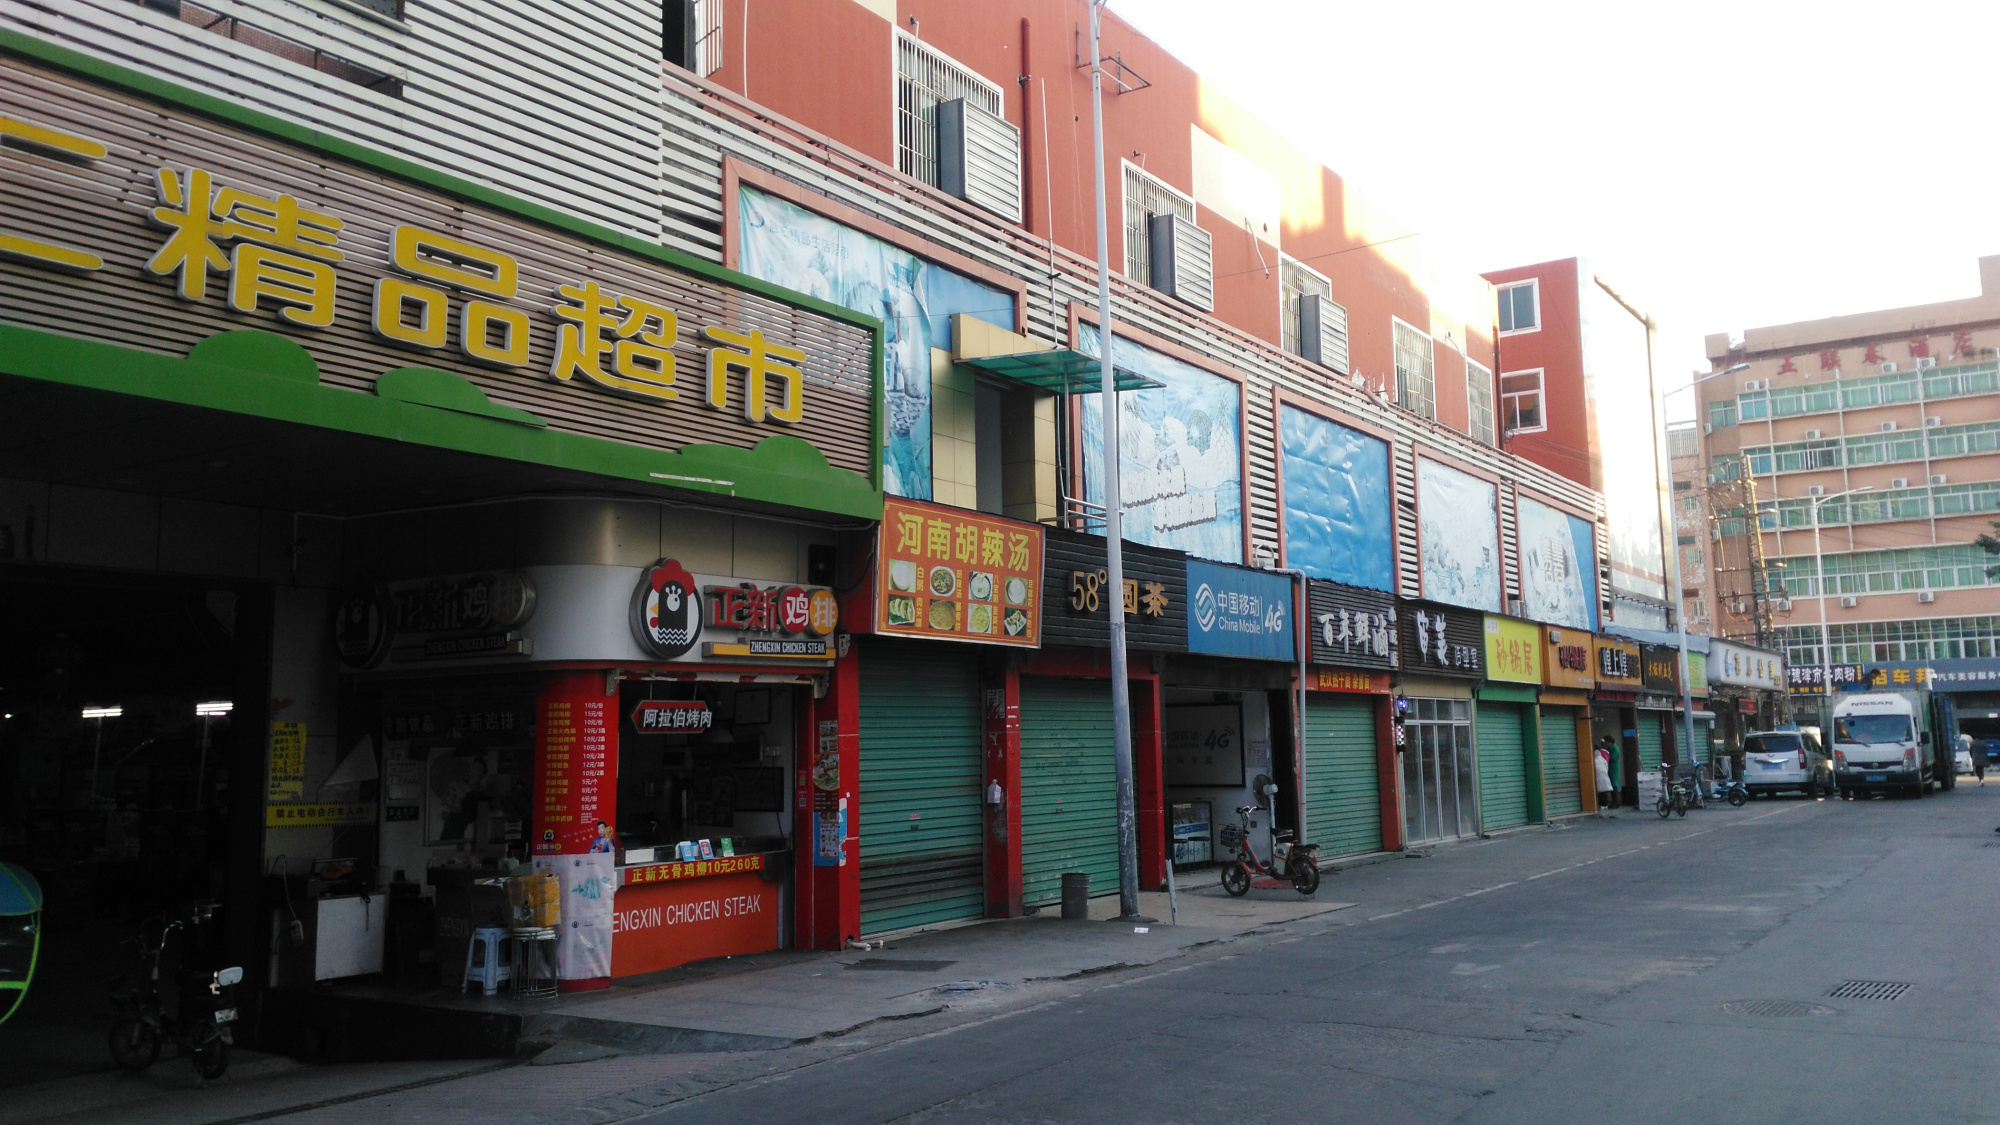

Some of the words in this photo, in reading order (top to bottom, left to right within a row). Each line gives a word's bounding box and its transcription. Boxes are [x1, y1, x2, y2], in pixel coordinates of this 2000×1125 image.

[897, 511, 1030, 572] 河南胡辣汤
[713, 586, 838, 633] 正新鸡排
[1217, 590, 1260, 616] 中国移动
[1218, 617, 1238, 632] China
[1239, 619, 1260, 634] Mobile
[1265, 604, 1282, 633] 4G
[750, 640, 781, 653] ZHENGXIN
[782, 641, 806, 654] CHICKEN
[807, 642, 826, 655] STEAK
[1938, 671, 2000, 681] 汽车美容服务
[455, 711, 514, 731] 正新鸡排
[643, 708, 713, 728] 阿拉伯烤肉
[1204, 729, 1229, 751] 4G
[631, 855, 760, 883] 正新无骨鸡柳10元260克
[666, 899, 720, 925] CHICKEN
[724, 894, 761, 917] STEAK
